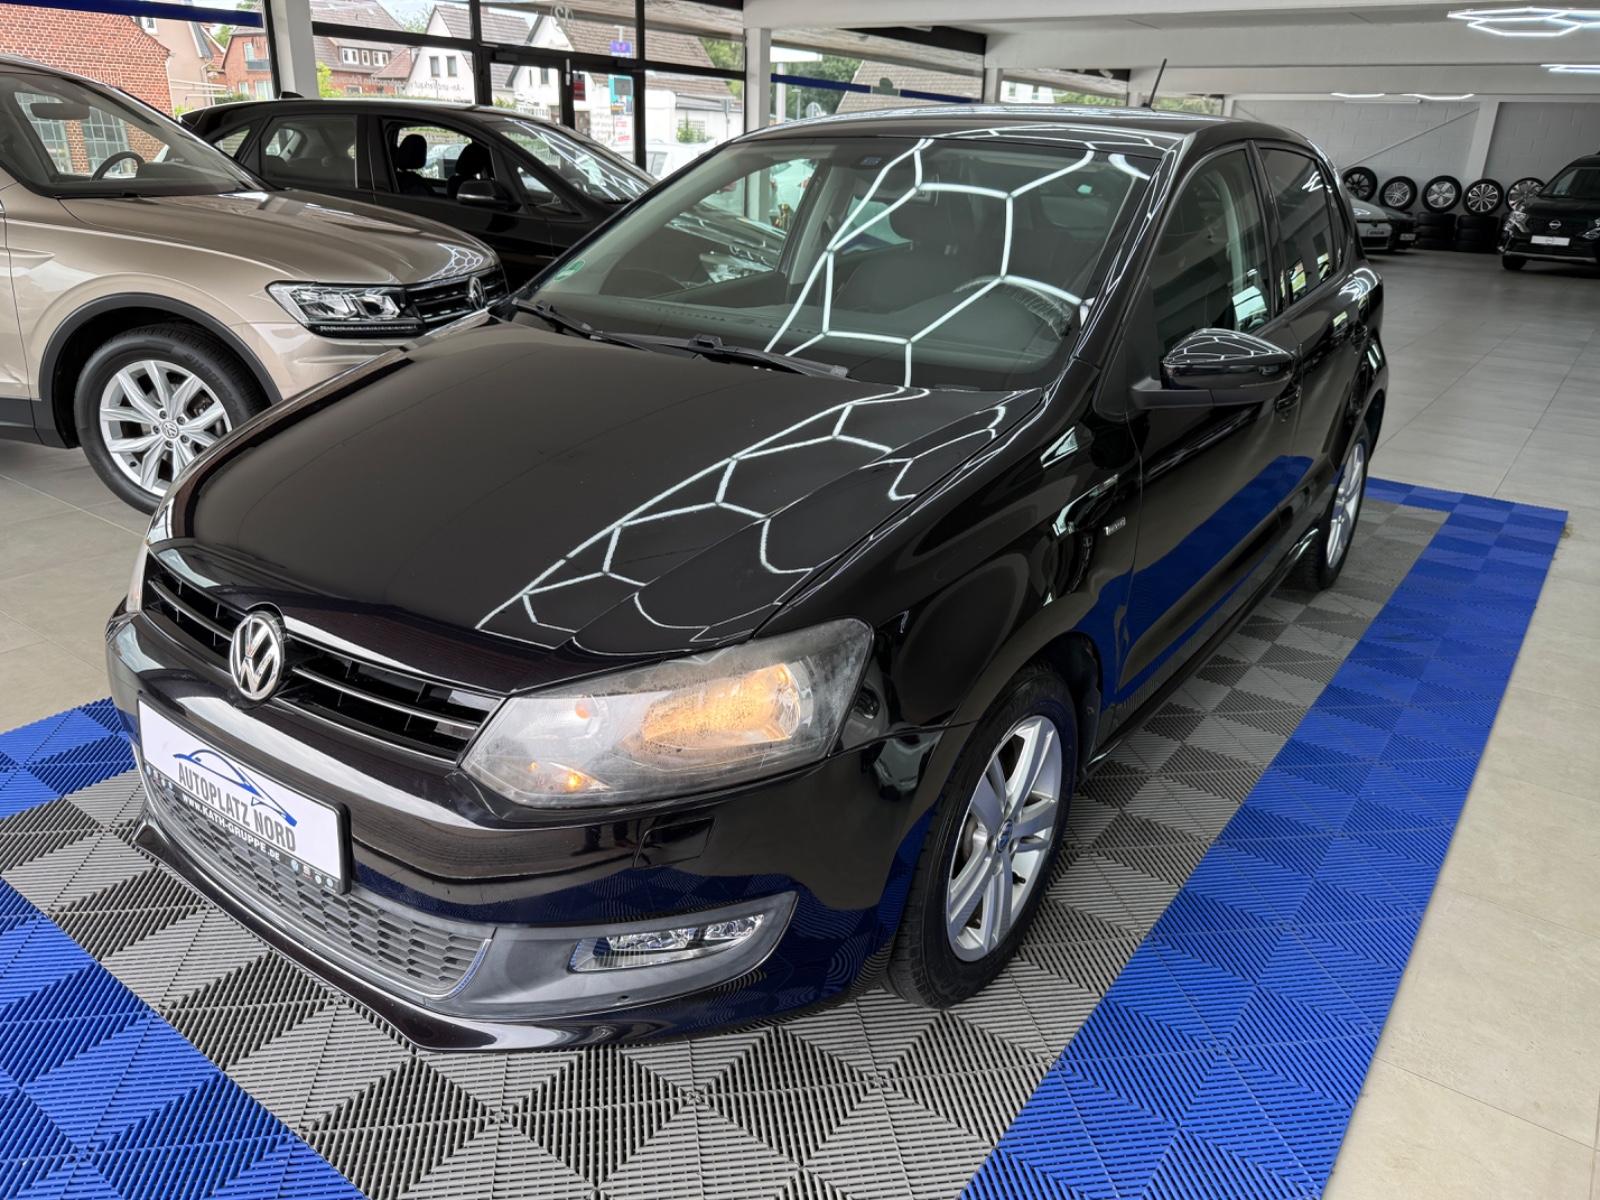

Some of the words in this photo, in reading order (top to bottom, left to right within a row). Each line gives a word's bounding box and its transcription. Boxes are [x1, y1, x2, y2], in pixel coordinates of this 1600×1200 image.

[230, 613, 281, 700] VW
[178, 762, 250, 827] AUTOPLATZ
[254, 809, 296, 852] NORD
